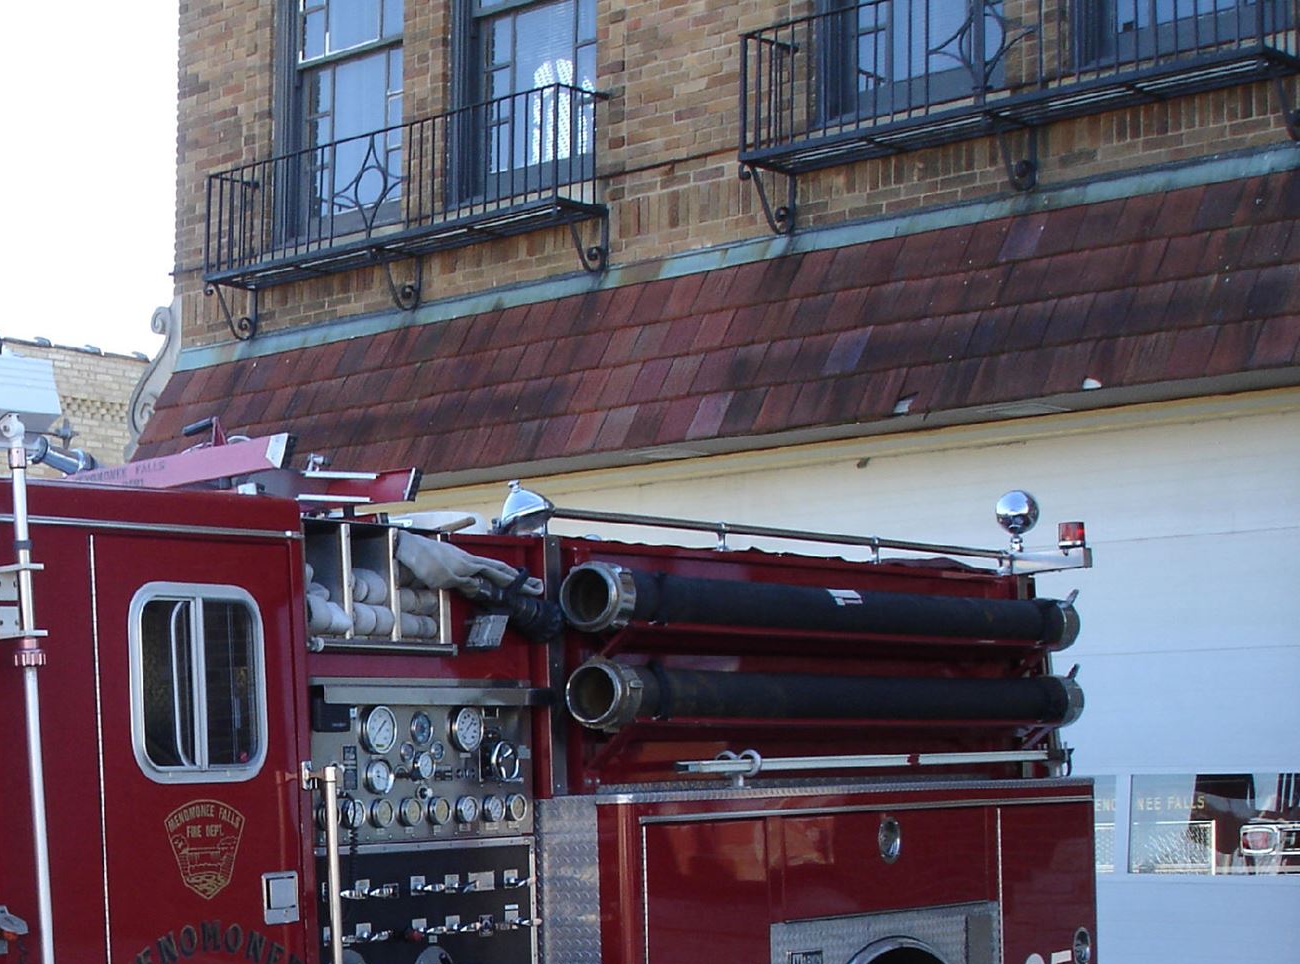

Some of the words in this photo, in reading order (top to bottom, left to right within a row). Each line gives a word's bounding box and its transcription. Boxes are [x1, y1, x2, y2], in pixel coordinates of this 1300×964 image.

[135, 459, 166, 475] FALLS
[1167, 794, 1205, 811] FALLS
[167, 804, 215, 833] MENOMONEE
[218, 806, 241, 829] FALLS
[186, 824, 202, 838] FIRE
